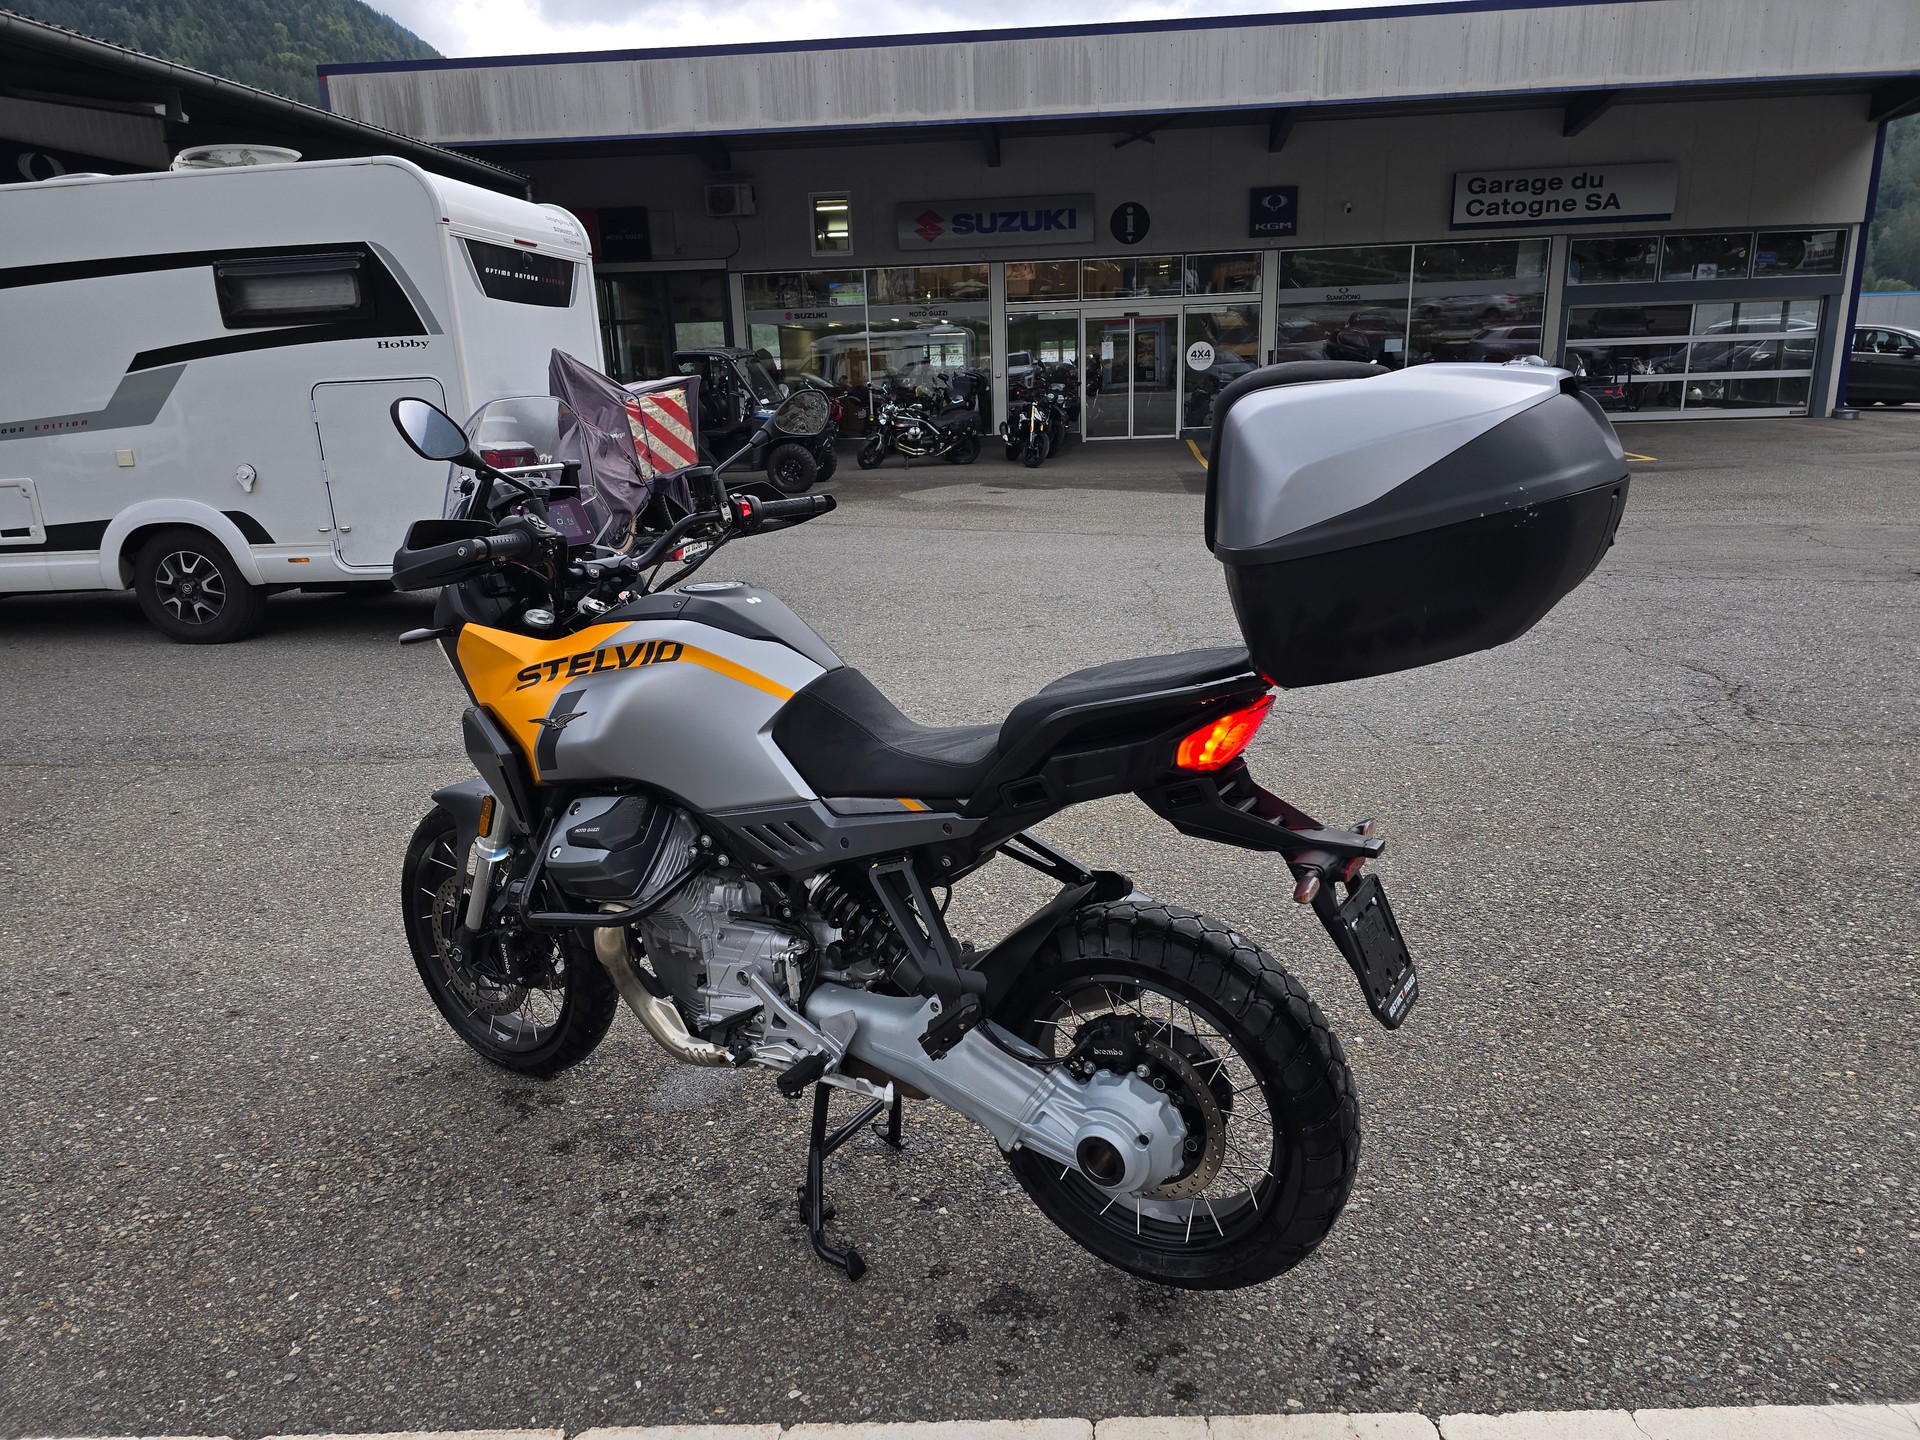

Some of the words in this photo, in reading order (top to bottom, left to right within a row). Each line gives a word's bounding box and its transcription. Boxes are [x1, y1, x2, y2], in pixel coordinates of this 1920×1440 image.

[1467, 176, 1563, 195] Garage
[1571, 172, 1604, 189] du
[1466, 199, 1577, 217] Catogne
[1585, 193, 1621, 211] SA
[951, 208, 1077, 235] SUZUKI
[1255, 221, 1292, 231] KGM
[485, 267, 511, 277] OPTIMA
[794, 311, 828, 320] SUZUKI
[377, 339, 430, 349] Hobby
[34, 420, 88, 431] EDITION
[515, 640, 685, 692] STELVIO
[501, 943, 511, 975] brembo
[1093, 1047, 1123, 1056] brembo
